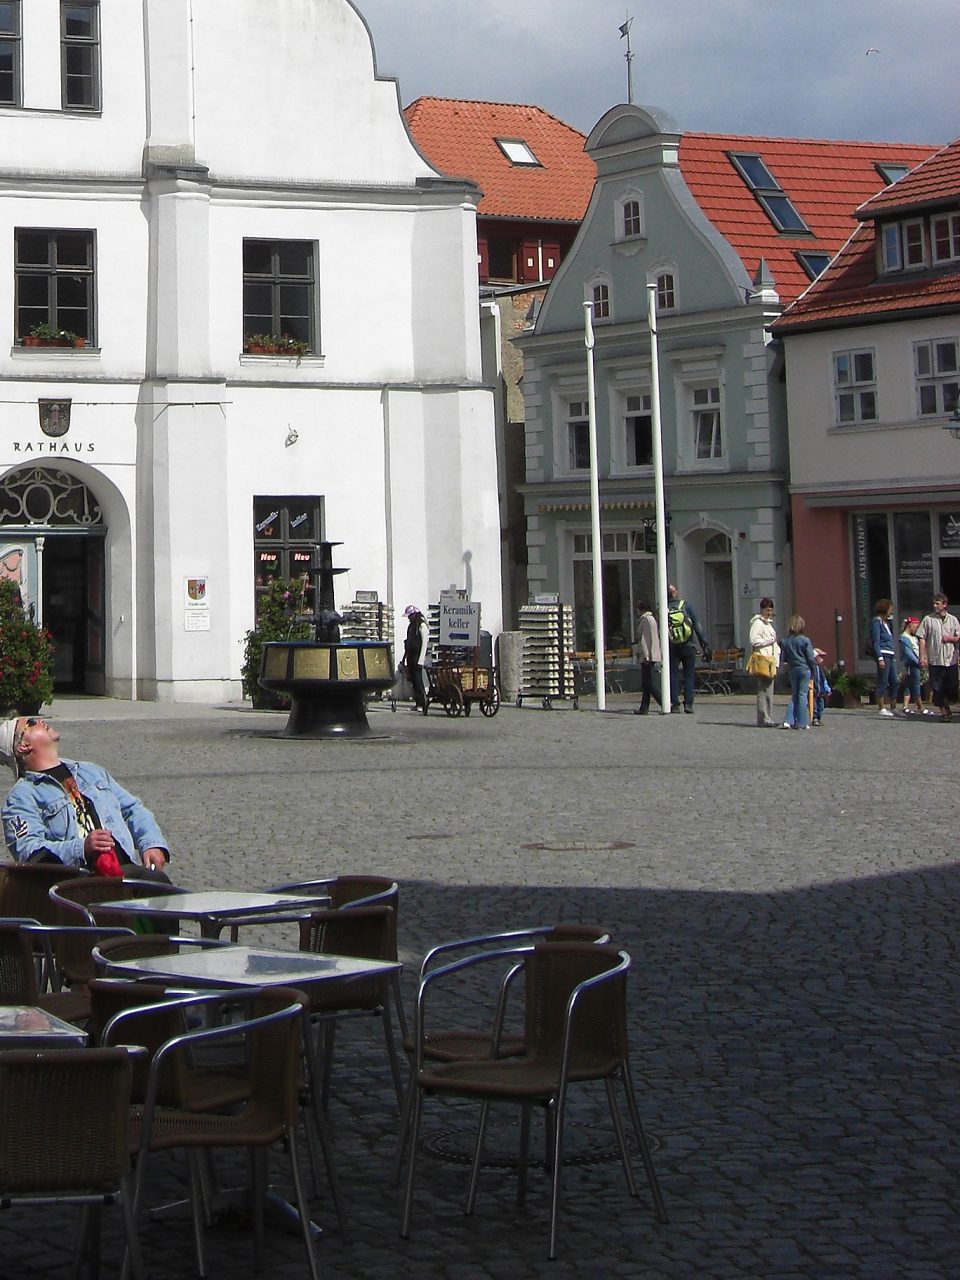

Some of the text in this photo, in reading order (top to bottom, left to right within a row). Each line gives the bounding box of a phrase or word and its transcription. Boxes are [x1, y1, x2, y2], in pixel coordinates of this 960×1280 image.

[13, 442, 95, 452] RATHAUS
[856, 519, 867, 579] AUSKUNFT
[443, 604, 476, 615] Keramik-
[448, 618, 470, 629] keller
